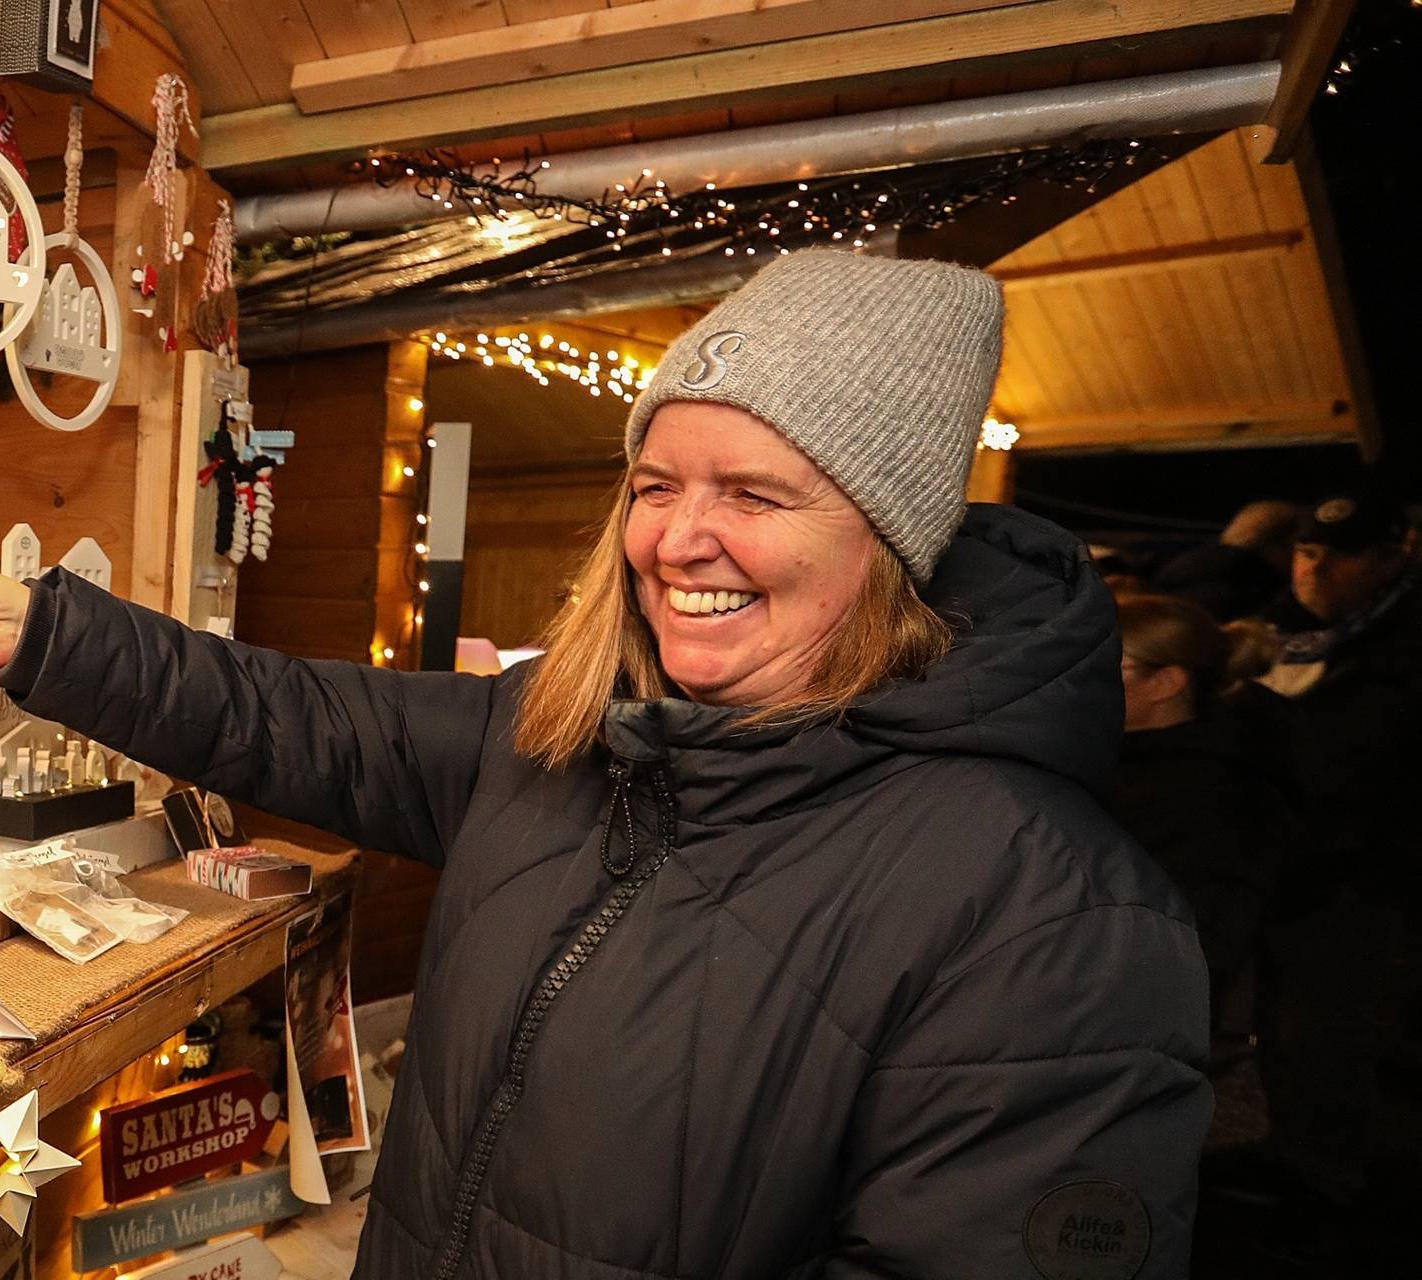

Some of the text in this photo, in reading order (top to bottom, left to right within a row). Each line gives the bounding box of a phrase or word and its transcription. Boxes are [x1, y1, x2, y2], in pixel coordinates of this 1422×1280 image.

[678, 331, 747, 391] S
[122, 1091, 233, 1157] SANTA'S
[123, 1126, 250, 1180] WORKSHOP
[110, 1190, 261, 1255] Winter Wonderland
